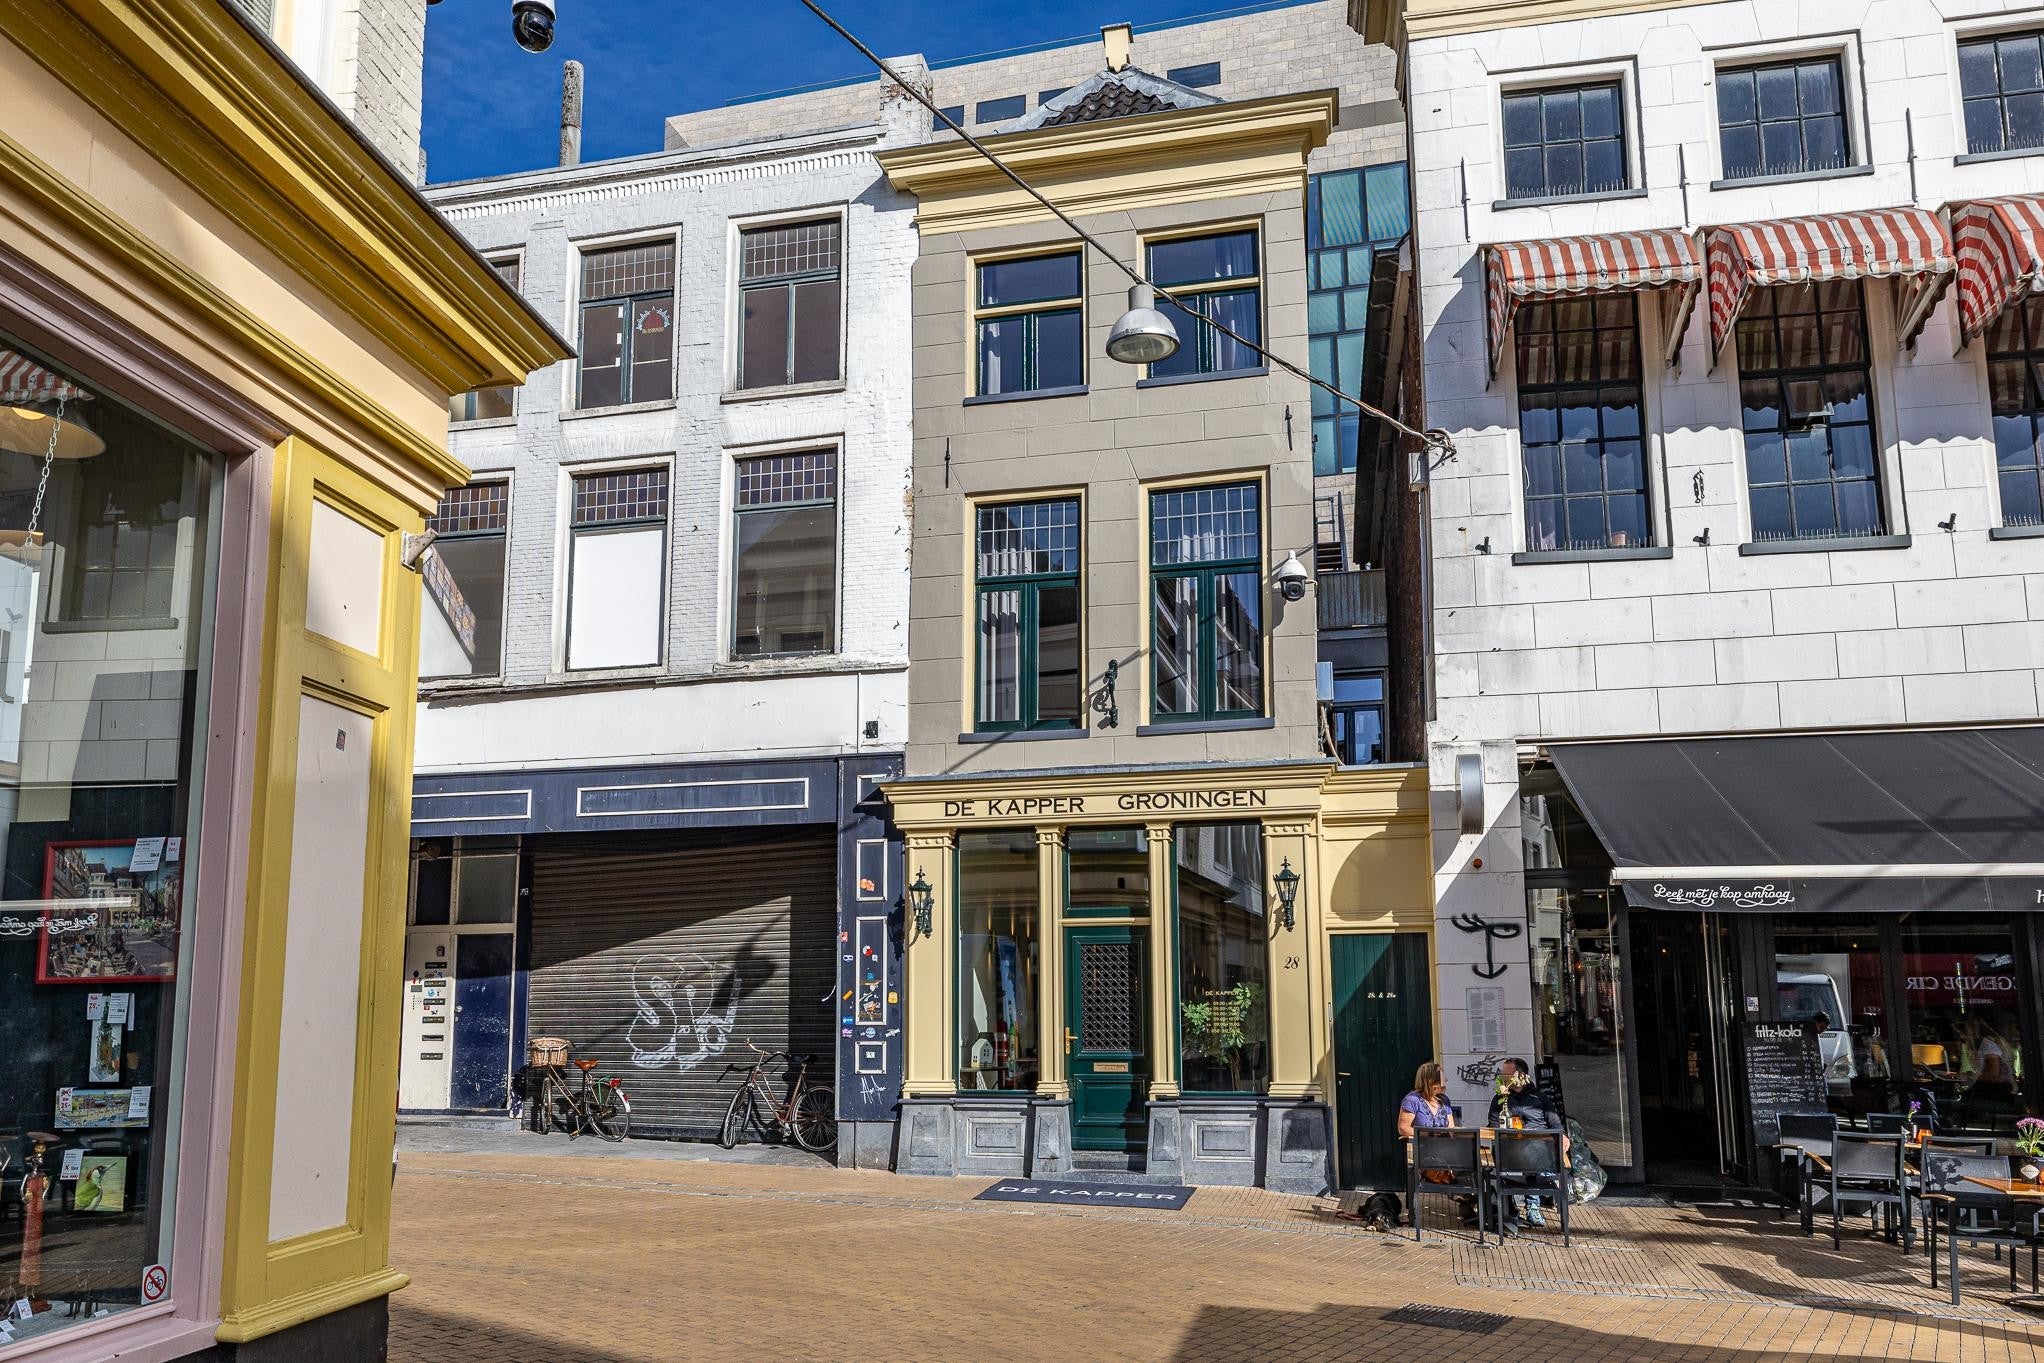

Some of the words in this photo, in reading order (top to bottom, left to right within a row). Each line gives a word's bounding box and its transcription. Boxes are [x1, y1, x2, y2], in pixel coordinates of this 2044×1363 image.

[944, 799, 975, 817] DE
[988, 797, 1085, 816] KAPPER
[1117, 789, 1267, 811] GRONINGEN
[1653, 883, 1685, 903] Leef
[1686, 887, 1710, 899] met
[1700, 888, 1719, 907] je
[1719, 885, 1742, 901] kop
[1744, 884, 1795, 907] omhoog
[1283, 956, 1300, 970] 28
[1755, 1024, 1802, 1038] fritz-kola
[997, 1186, 1041, 1194] DE
[1050, 1189, 1177, 1201] KAPPER
